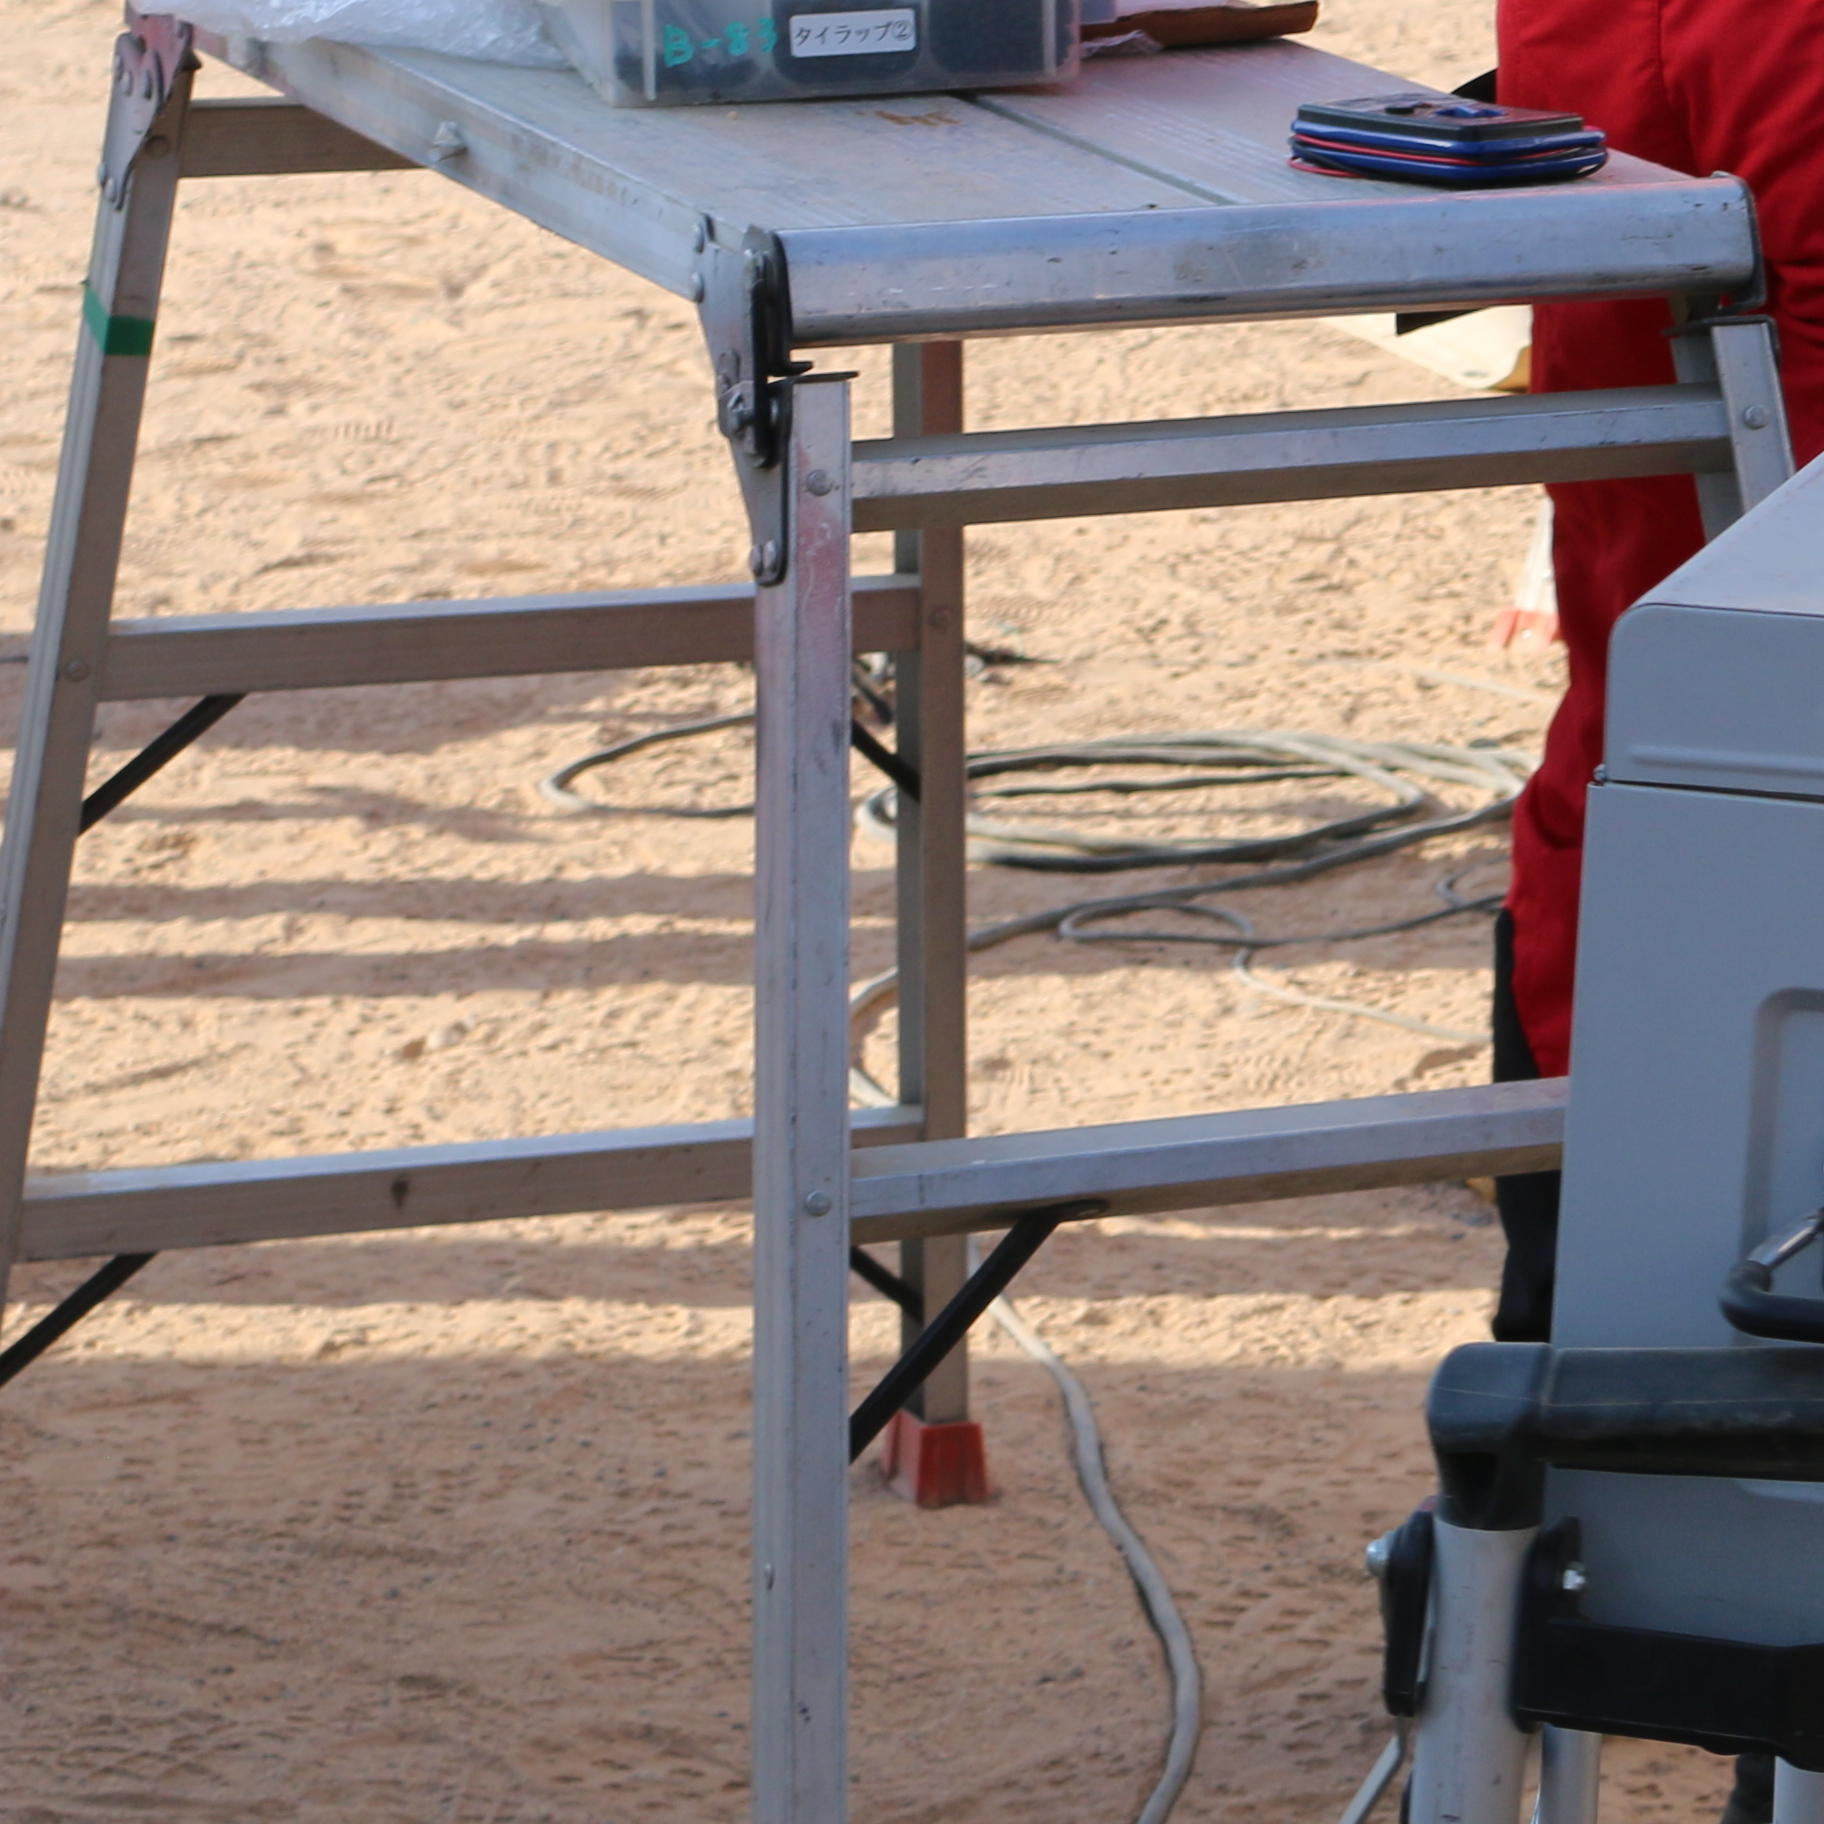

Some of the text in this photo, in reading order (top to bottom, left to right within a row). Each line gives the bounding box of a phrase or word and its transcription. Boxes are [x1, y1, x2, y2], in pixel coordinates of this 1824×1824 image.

[663, 16, 779, 69] B-83
[793, 20, 914, 46] タイラップ②
